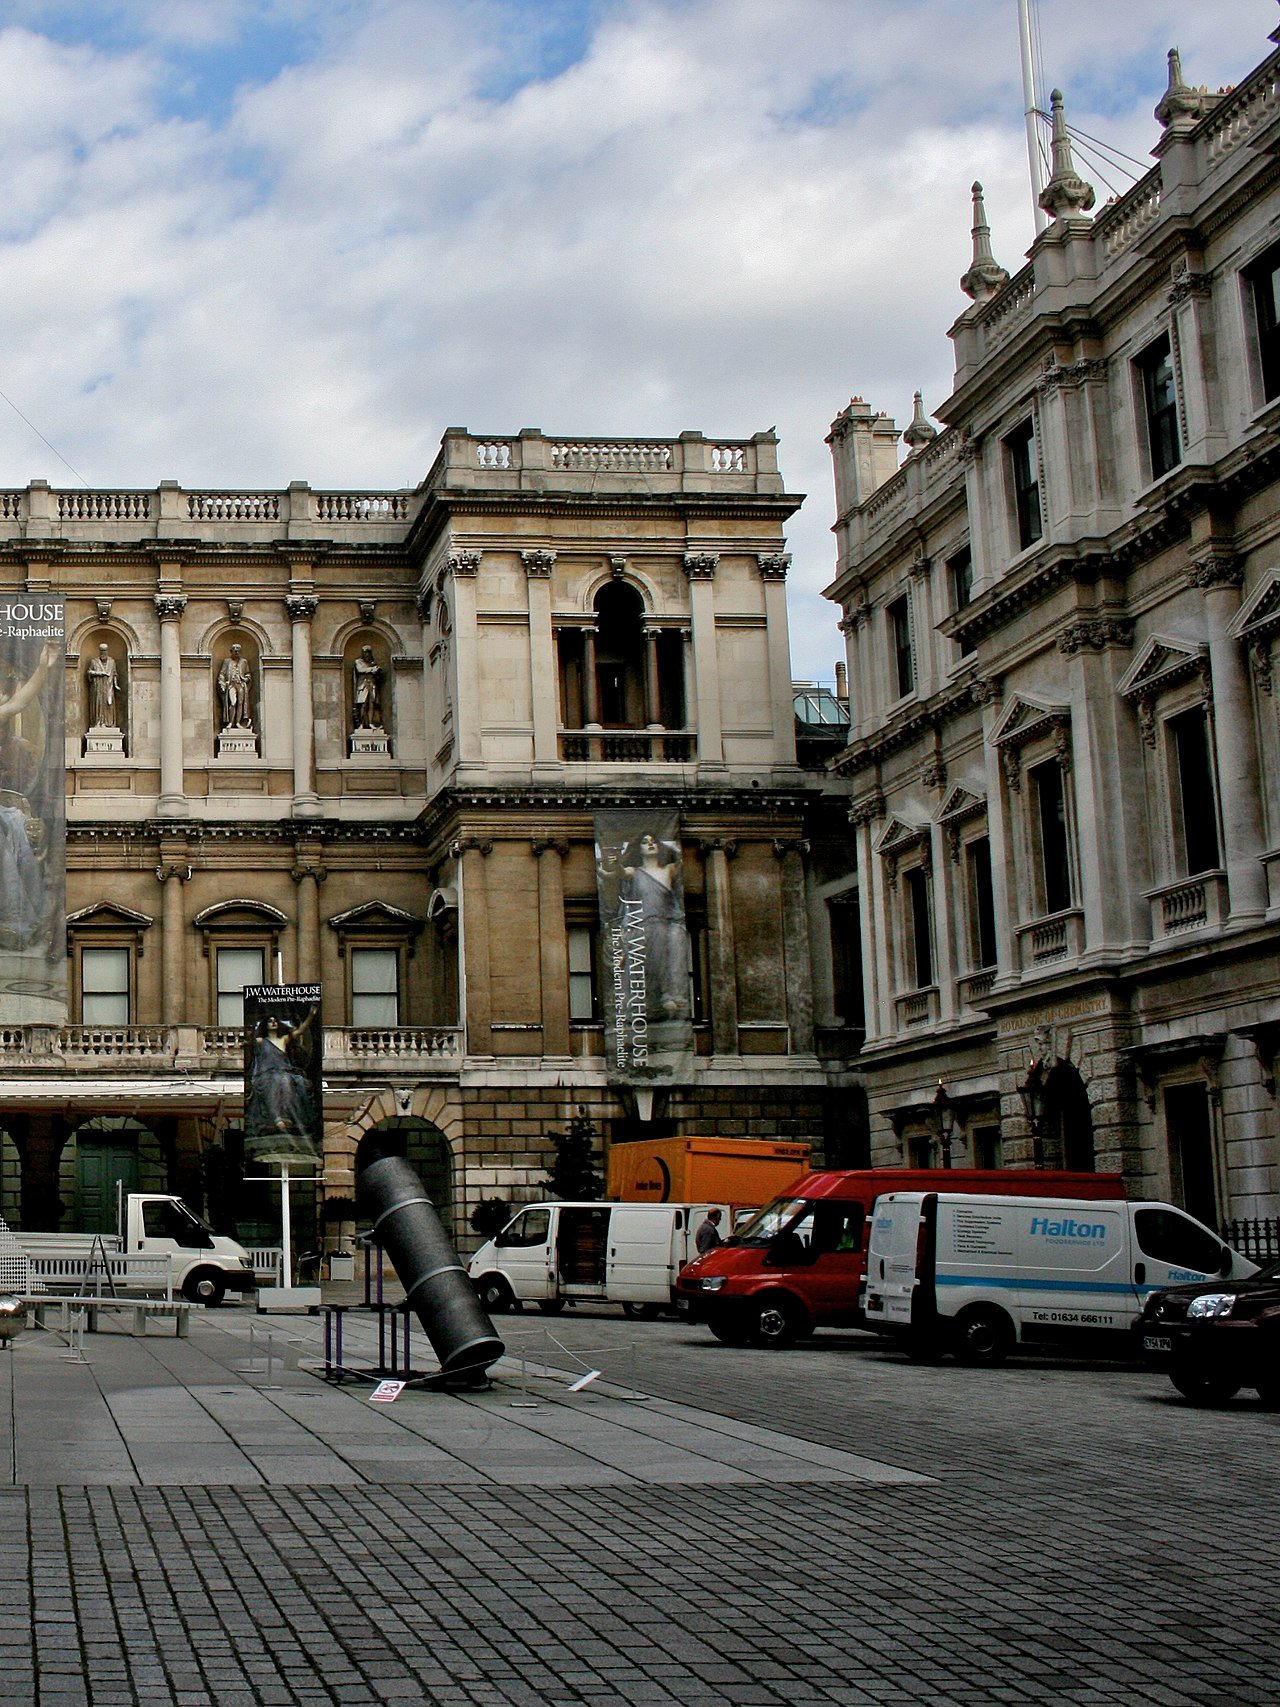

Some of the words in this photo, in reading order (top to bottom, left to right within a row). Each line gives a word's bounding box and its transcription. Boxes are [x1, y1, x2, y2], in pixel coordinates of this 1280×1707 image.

[619, 896, 644, 932] J.W.
[611, 927, 621, 945] The
[613, 948, 624, 989] Modern
[246, 987, 261, 999] J.W.
[263, 986, 320, 996] WATERHOUSE
[627, 936, 648, 1067] WATERHOUSE
[613, 993, 628, 1068] Pre-Raphaelite
[1030, 1217, 1106, 1238] Halton
[1168, 1270, 1207, 1281] Halton
[1032, 1312, 1049, 1321] Tel:
[1051, 1313, 1078, 1322] 01634
[1081, 1314, 1113, 1324] 666111
